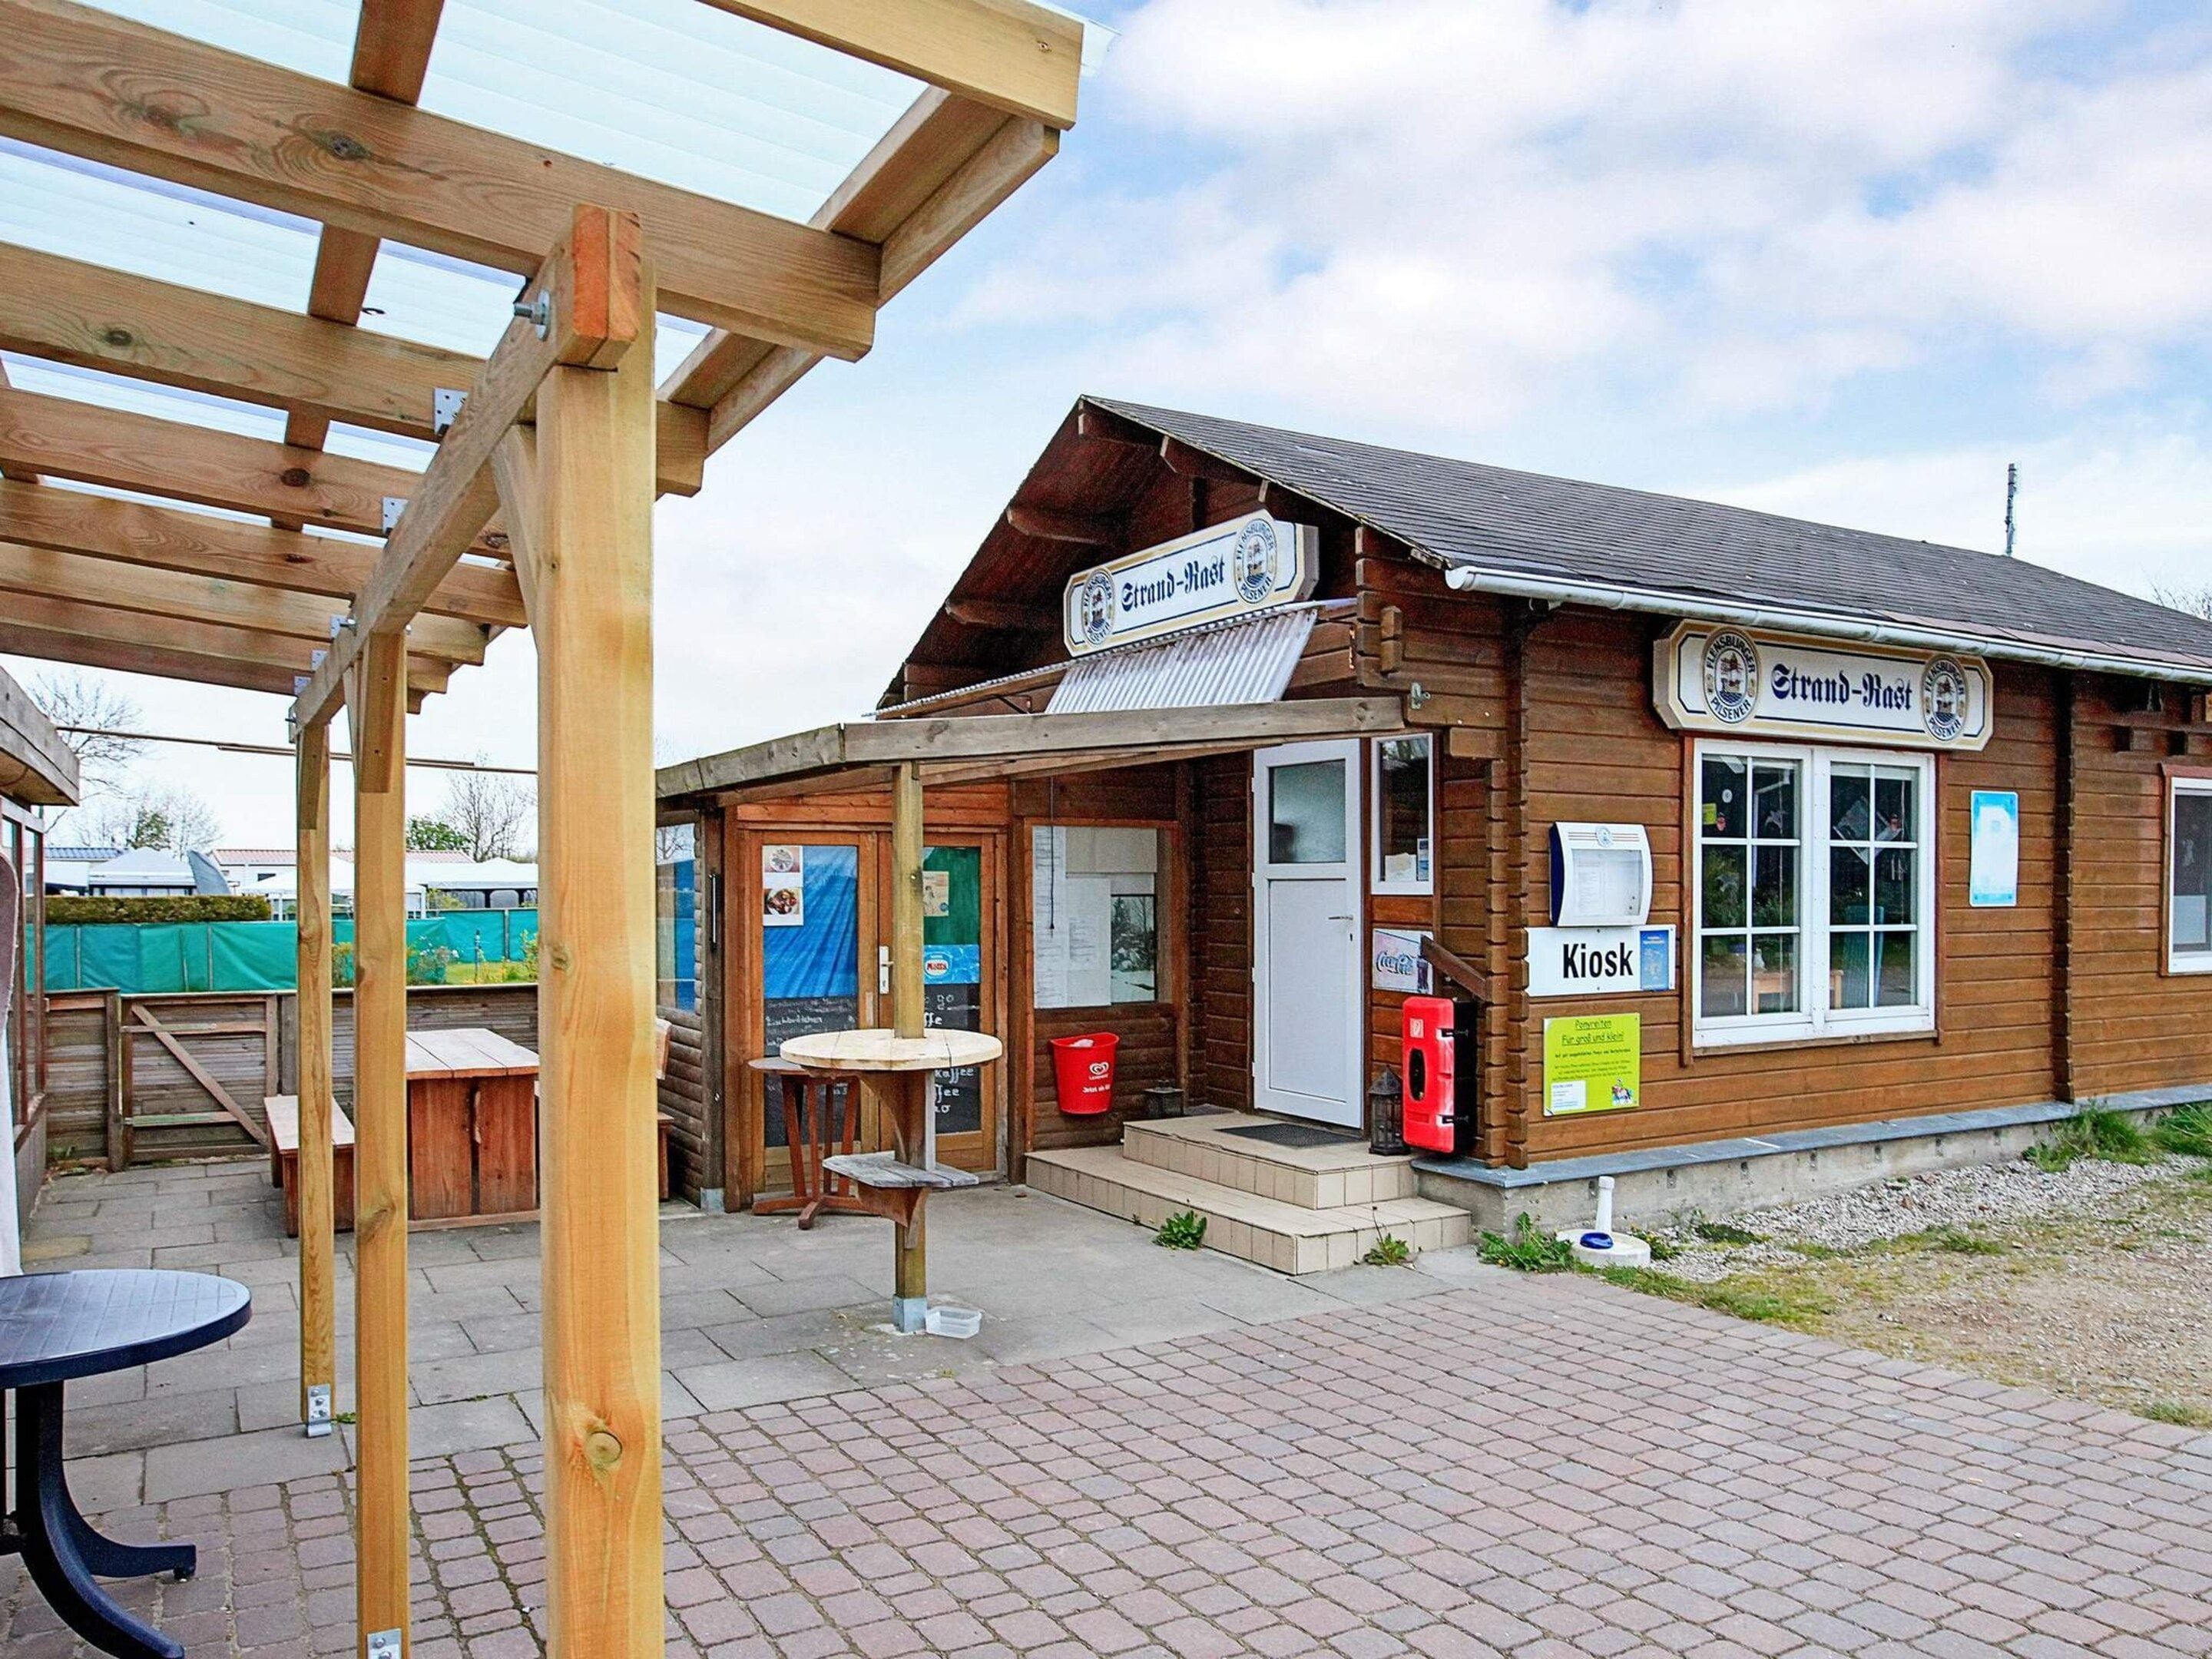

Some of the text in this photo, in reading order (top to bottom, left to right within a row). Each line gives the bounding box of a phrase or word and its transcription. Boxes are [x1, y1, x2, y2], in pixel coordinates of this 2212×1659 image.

[1121, 554, 1225, 611] Strand-Rast
[1706, 635, 1756, 674] FLENSBURGER
[1771, 663, 1912, 710] Strand-Rast
[1710, 696, 1752, 720] PILSENER
[1562, 942, 1634, 979] Kiosk
